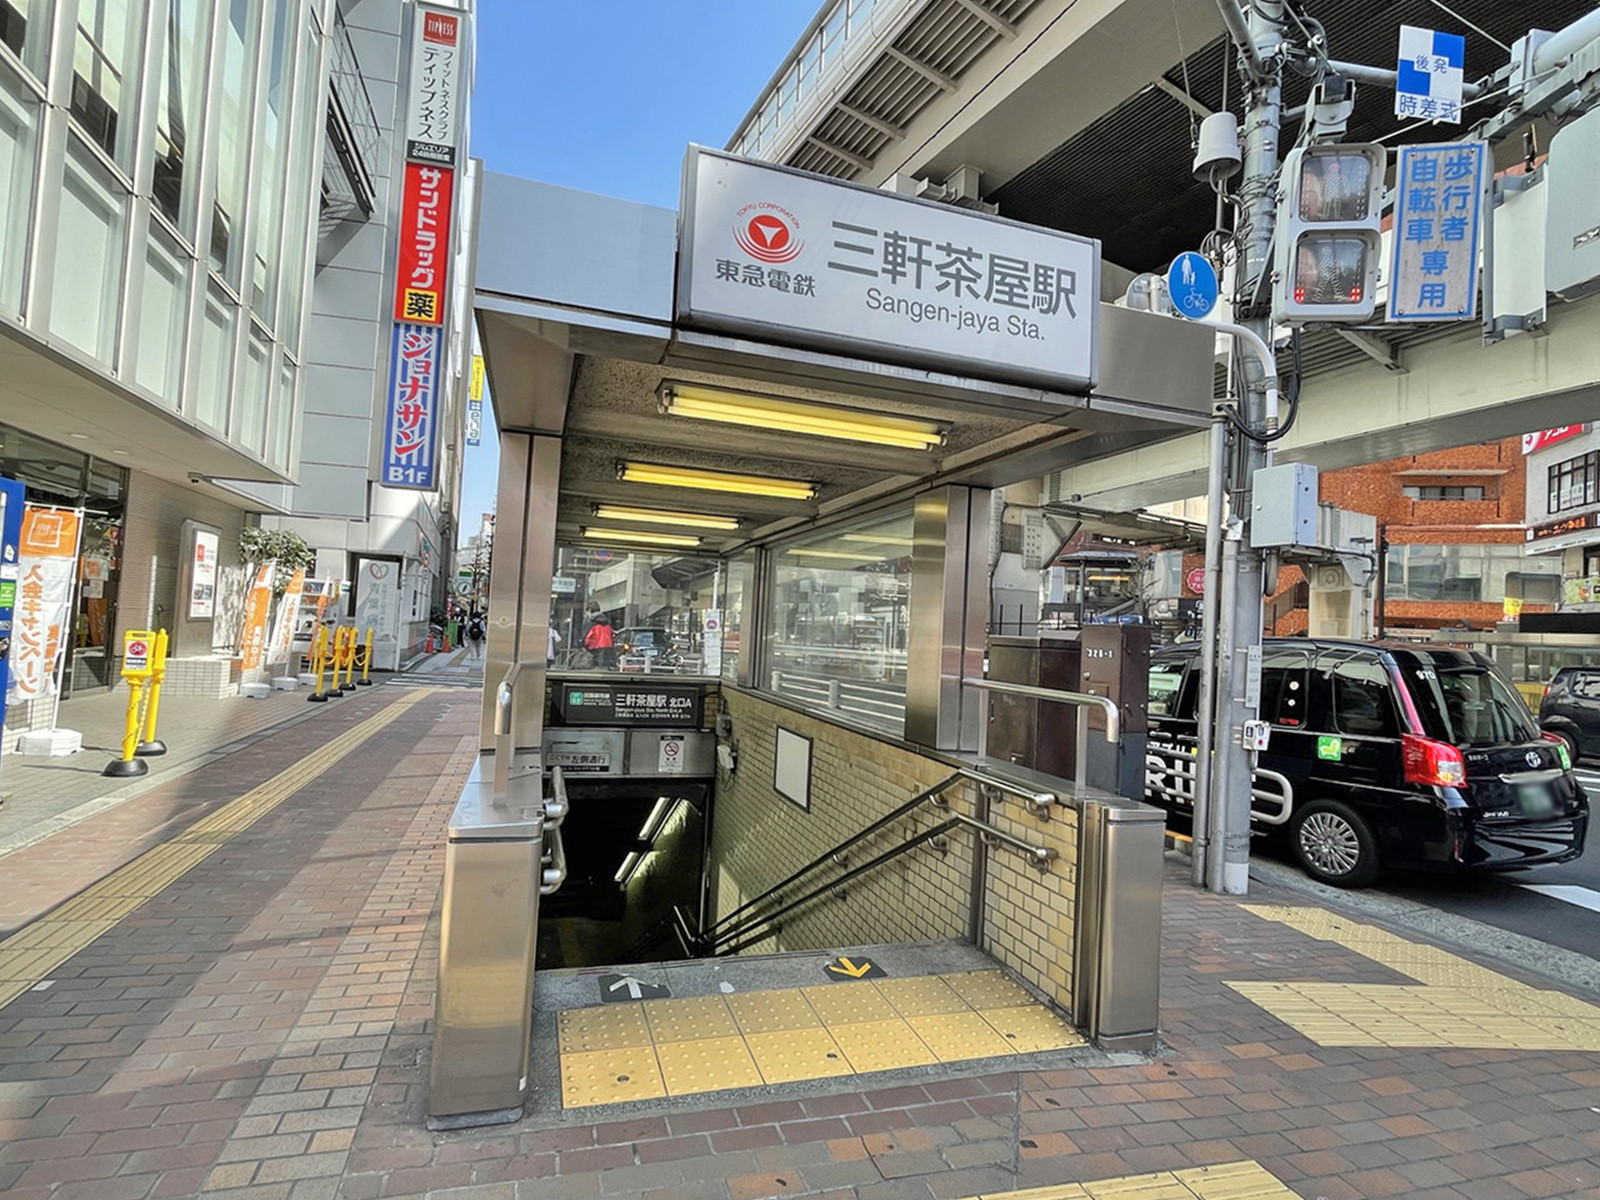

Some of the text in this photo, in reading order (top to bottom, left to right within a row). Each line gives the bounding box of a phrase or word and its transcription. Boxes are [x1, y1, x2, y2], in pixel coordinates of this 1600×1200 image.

[1415, 54, 1448, 75] 後発
[418, 47, 439, 139] ティップネス
[1399, 95, 1460, 121] 時差式
[737, 202, 800, 230] TOKYU CORPORATION
[1405, 156, 1438, 244] 自転車
[1440, 154, 1473, 242] 歩行者
[411, 167, 441, 289] サンドラッグ
[714, 258, 816, 298] 東急電鉄
[827, 219, 1077, 319] 三軒茶屋駅
[1418, 249, 1449, 308] 専用
[406, 291, 435, 318] 薬
[866, 288, 1046, 341] Sangen-jaya Sta.
[394, 333, 432, 455] ジョナサン
[388, 465, 427, 484] B1F
[615, 693, 667, 707] 三軒茶屋駅
[669, 697, 692, 708] 北口A
